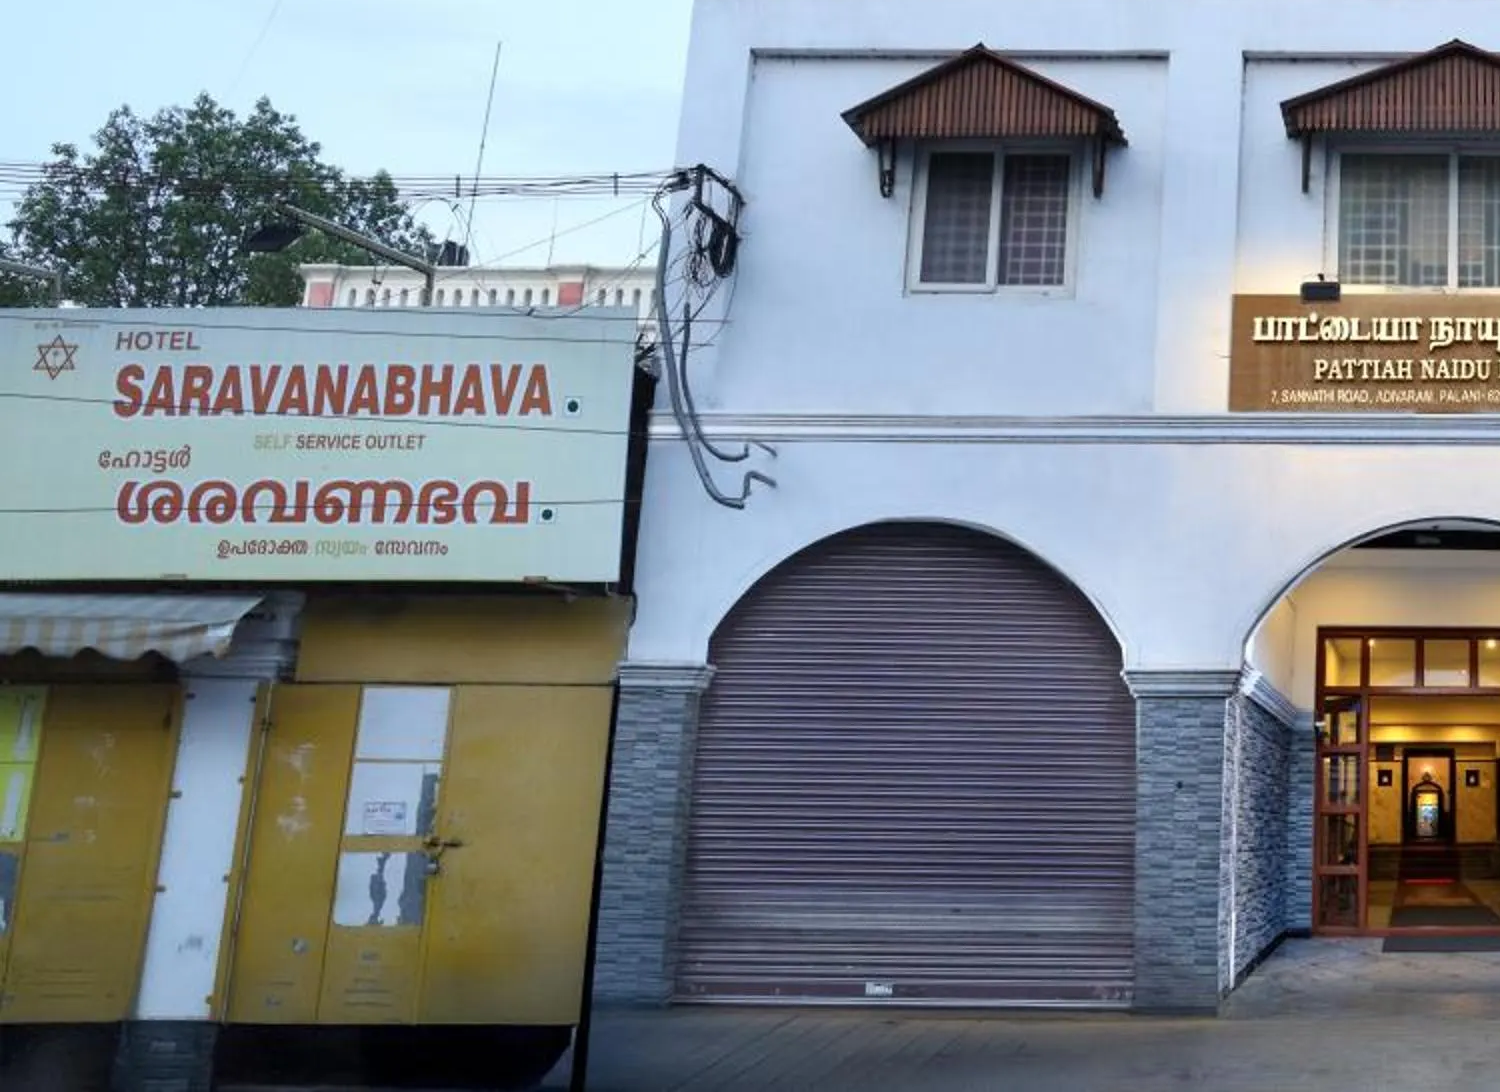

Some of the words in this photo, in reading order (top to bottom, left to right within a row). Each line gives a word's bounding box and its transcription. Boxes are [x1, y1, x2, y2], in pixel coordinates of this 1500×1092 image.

[115, 331, 201, 352] HOTEL
[1313, 359, 1413, 381] PATTIAH
[1421, 359, 1491, 380] NAIDU
[112, 364, 553, 419] SARAVANABHAVA
[253, 434, 292, 450] SELF
[295, 435, 361, 450] SERVICE
[365, 434, 426, 450] OUTLET
[117, 480, 530, 525] ശരവണഭവ
